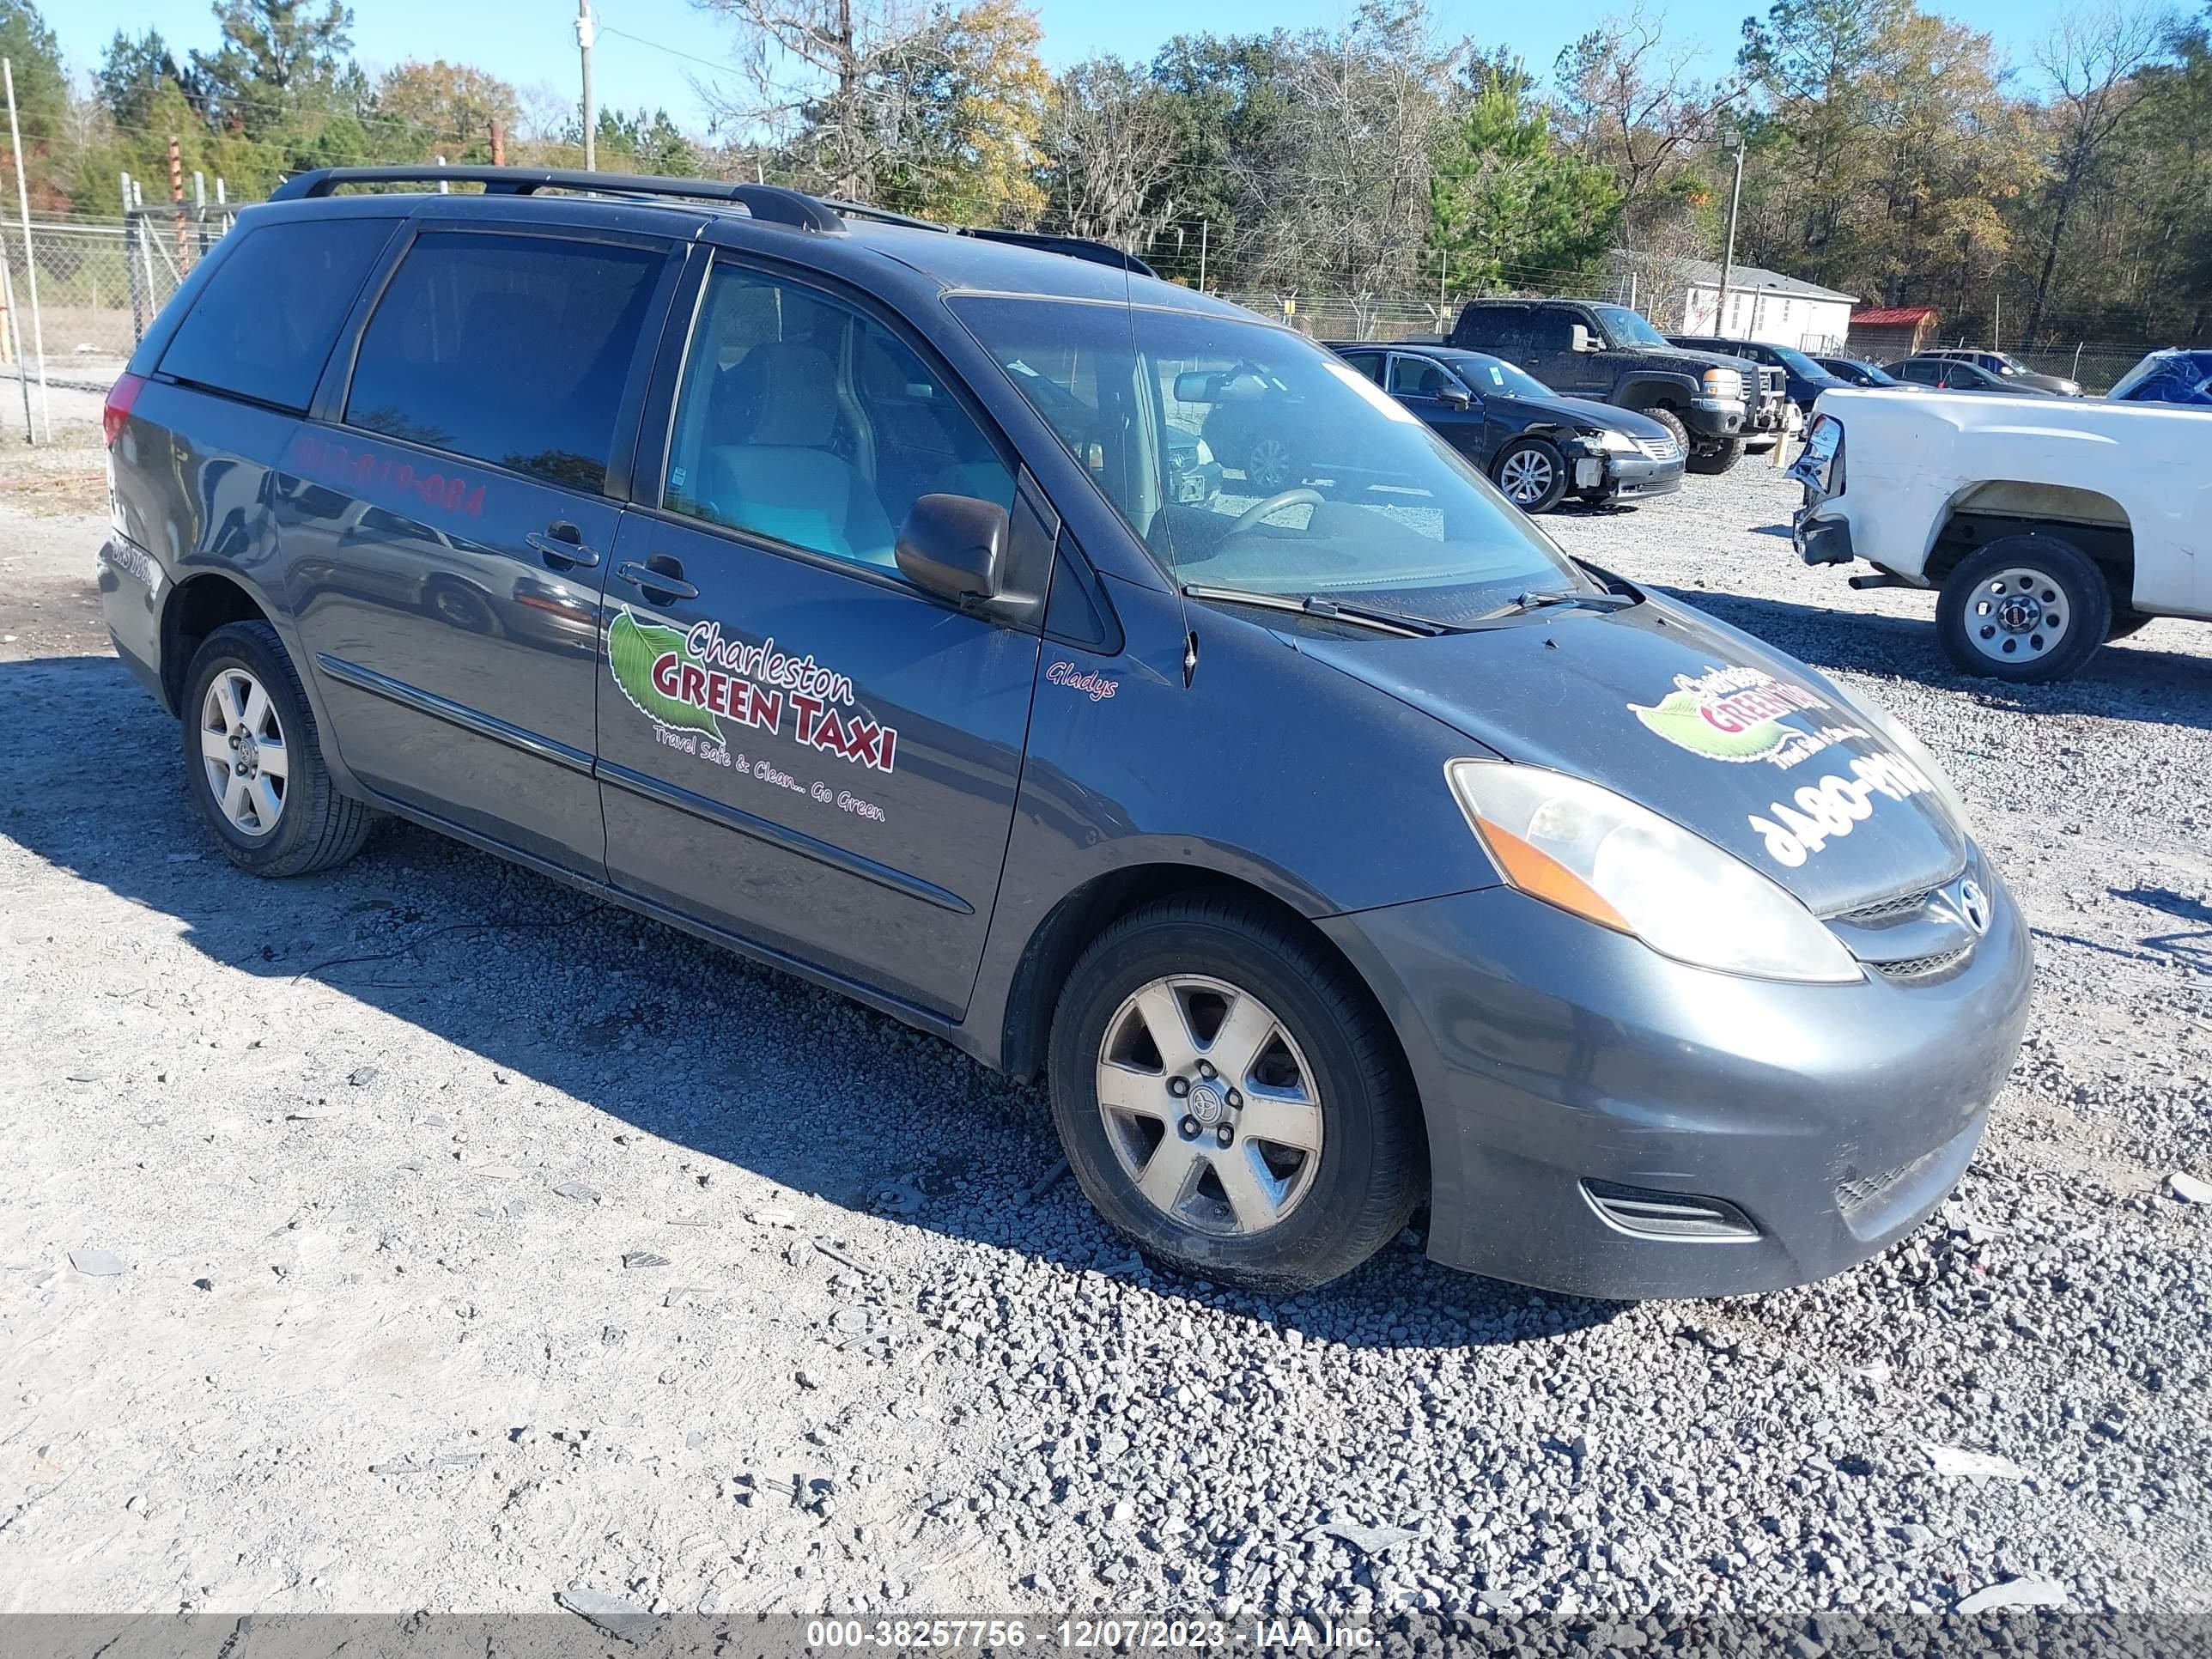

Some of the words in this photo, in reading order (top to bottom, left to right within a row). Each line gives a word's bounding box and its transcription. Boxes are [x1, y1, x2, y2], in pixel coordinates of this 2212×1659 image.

[686, 620, 855, 706] Charleston
[1046, 661, 1119, 702] Gladys
[651, 651, 783, 736] GREEN
[789, 691, 897, 774] TAXI
[1698, 686, 1798, 733] GREEN
[653, 725, 696, 756] Travel
[701, 741, 732, 767] Safe
[736, 755, 750, 774] &
[754, 761, 806, 794] Clean...
[811, 781, 833, 804] Go
[836, 790, 886, 823] Green
